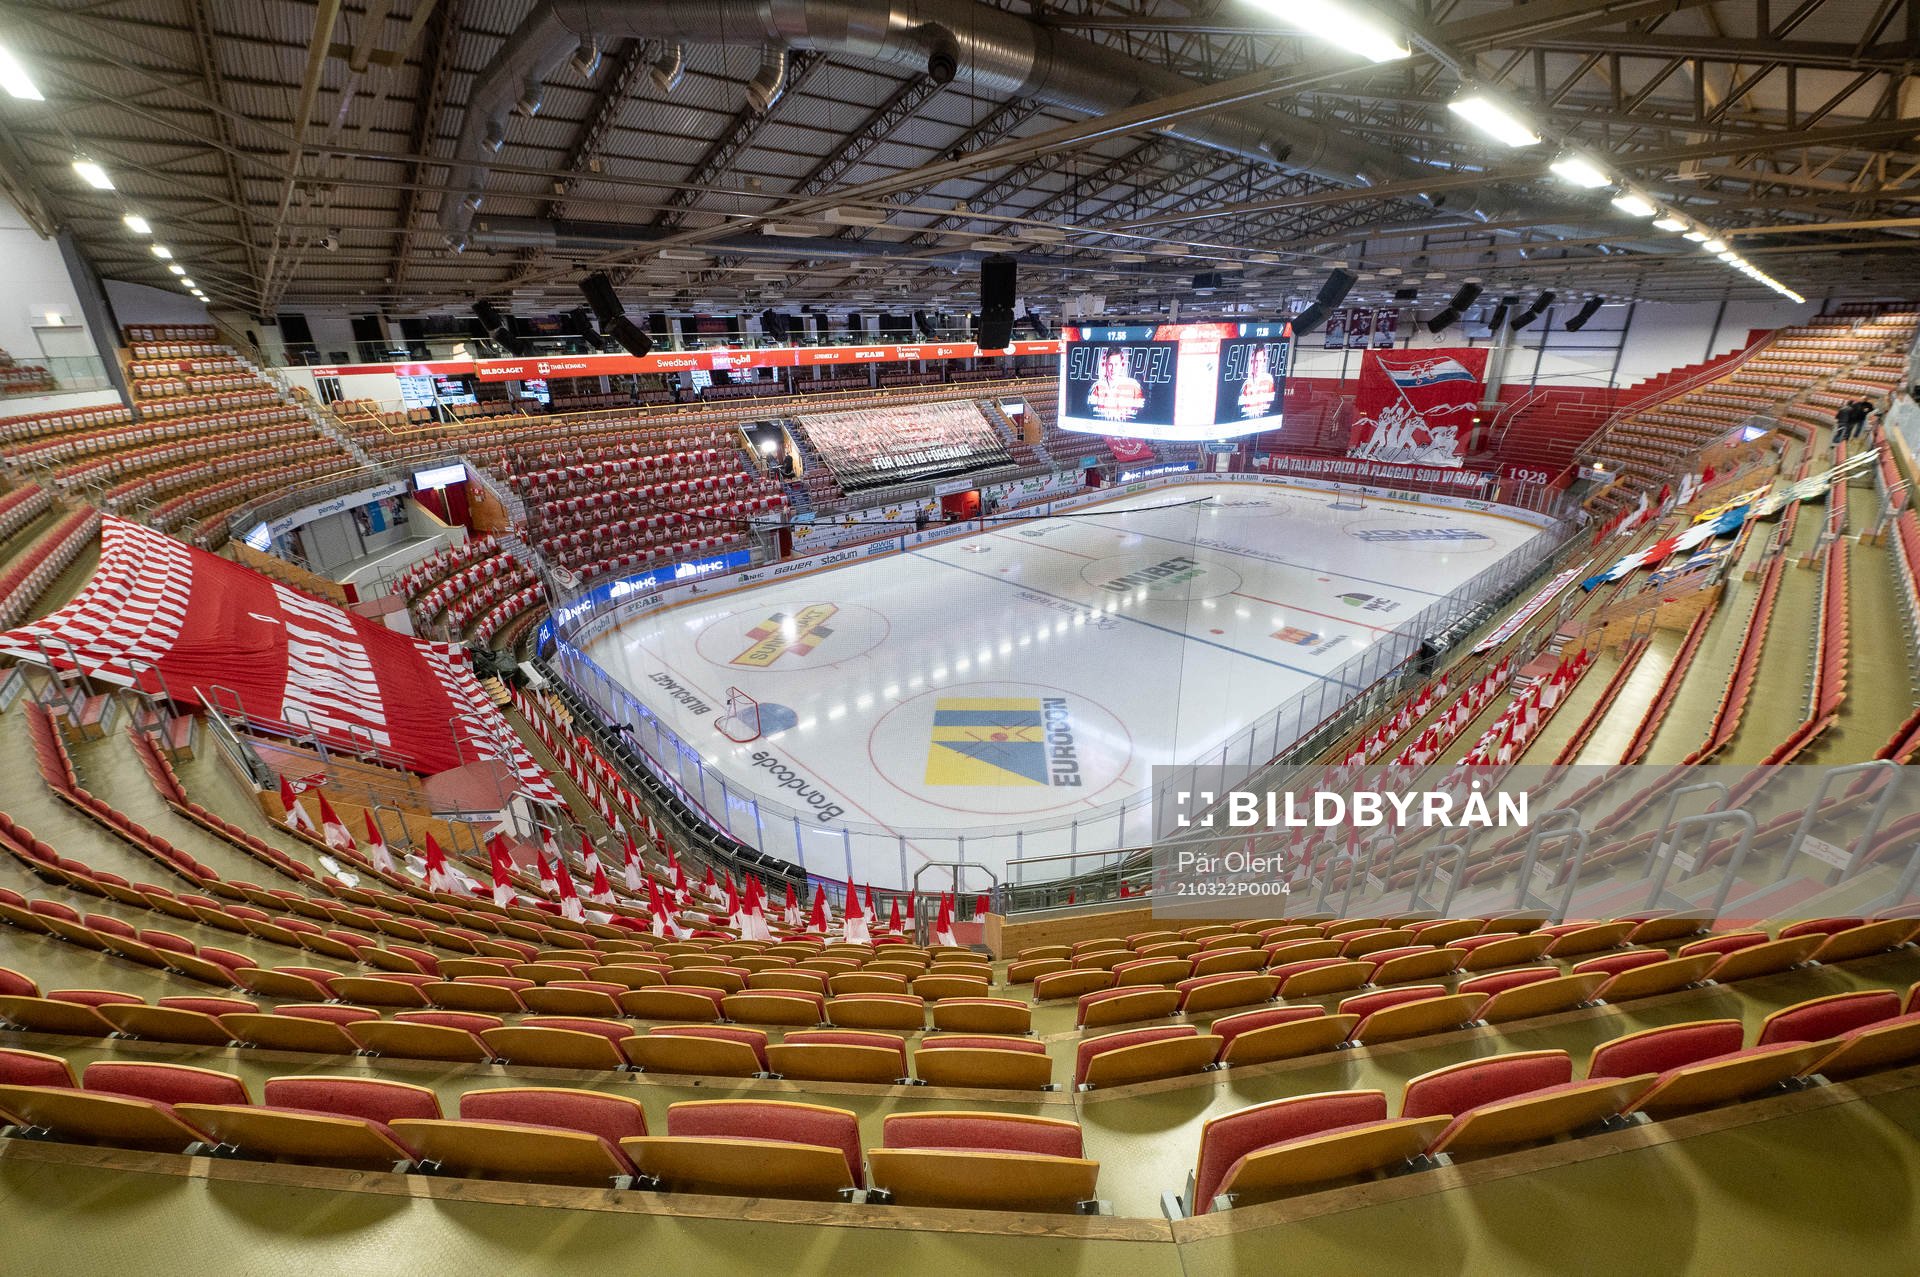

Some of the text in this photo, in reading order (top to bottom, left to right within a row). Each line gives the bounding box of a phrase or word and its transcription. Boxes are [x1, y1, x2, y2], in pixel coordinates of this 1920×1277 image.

[656, 358, 698, 368] Swedbank
[712, 354, 751, 366] permobil
[1069, 346, 1172, 383] SLUPEL
[480, 366, 524, 376] BILBOLAGET
[871, 453, 895, 471] FÖR
[894, 449, 927, 468] ALLTID
[924, 443, 974, 463] FÖRENADE
[1272, 455, 1477, 486] TVÅ TALLAR STOLTA PÅ FLAGGAN SOM VI BÄR
[1509, 467, 1548, 486] 1928
[371, 485, 397, 498] permobil
[317, 500, 345, 516] permobil
[272, 518, 294, 534] permobil
[928, 525, 962, 539] teamsters
[868, 539, 894, 550] JOWIC
[820, 549, 858, 565] stadium
[696, 561, 723, 573] NHC
[774, 560, 813, 575] BAUER
[1098, 556, 1200, 592] UNIBET
[630, 576, 656, 592] NHC
[570, 600, 592, 618] NHC
[647, 671, 712, 716] BILBOLAGET
[1043, 697, 1082, 786] EUROCON
[751, 751, 845, 823] Brandcode
